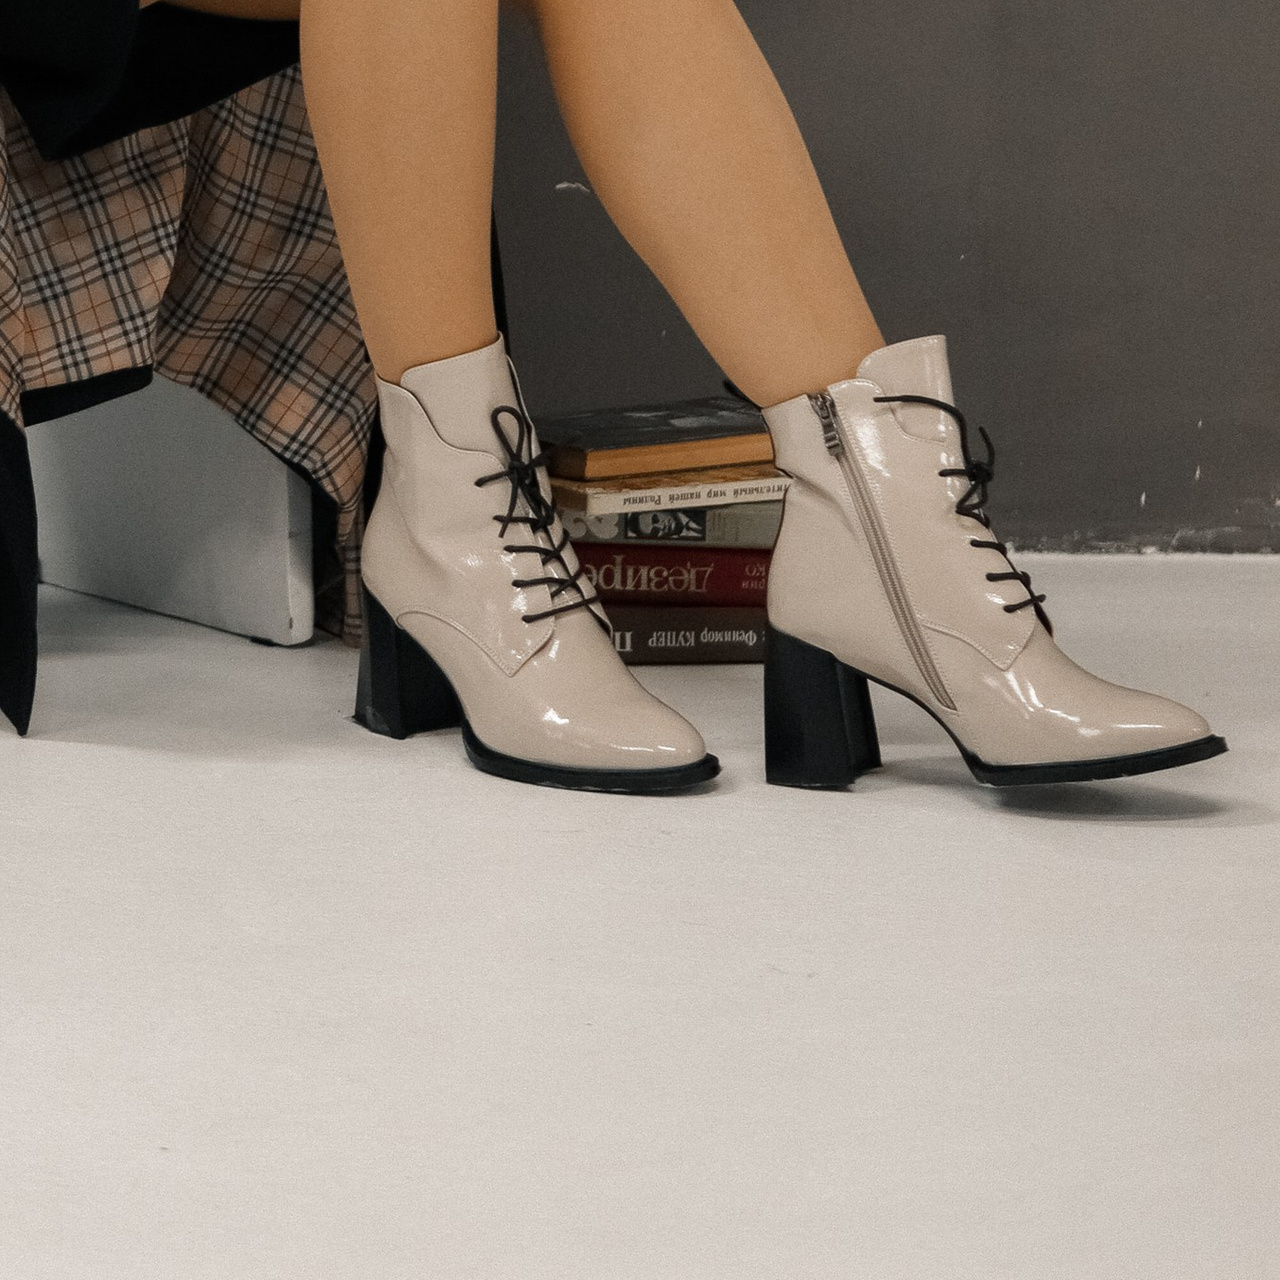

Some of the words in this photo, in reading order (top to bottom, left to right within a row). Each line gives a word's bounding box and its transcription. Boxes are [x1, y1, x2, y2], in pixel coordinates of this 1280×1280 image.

[623, 495, 662, 506] Родины
[669, 493, 702, 504] нашей
[706, 490, 727, 502] мир
[648, 630, 696, 647] КУПЕР
[700, 627, 757, 646] Фенимор
